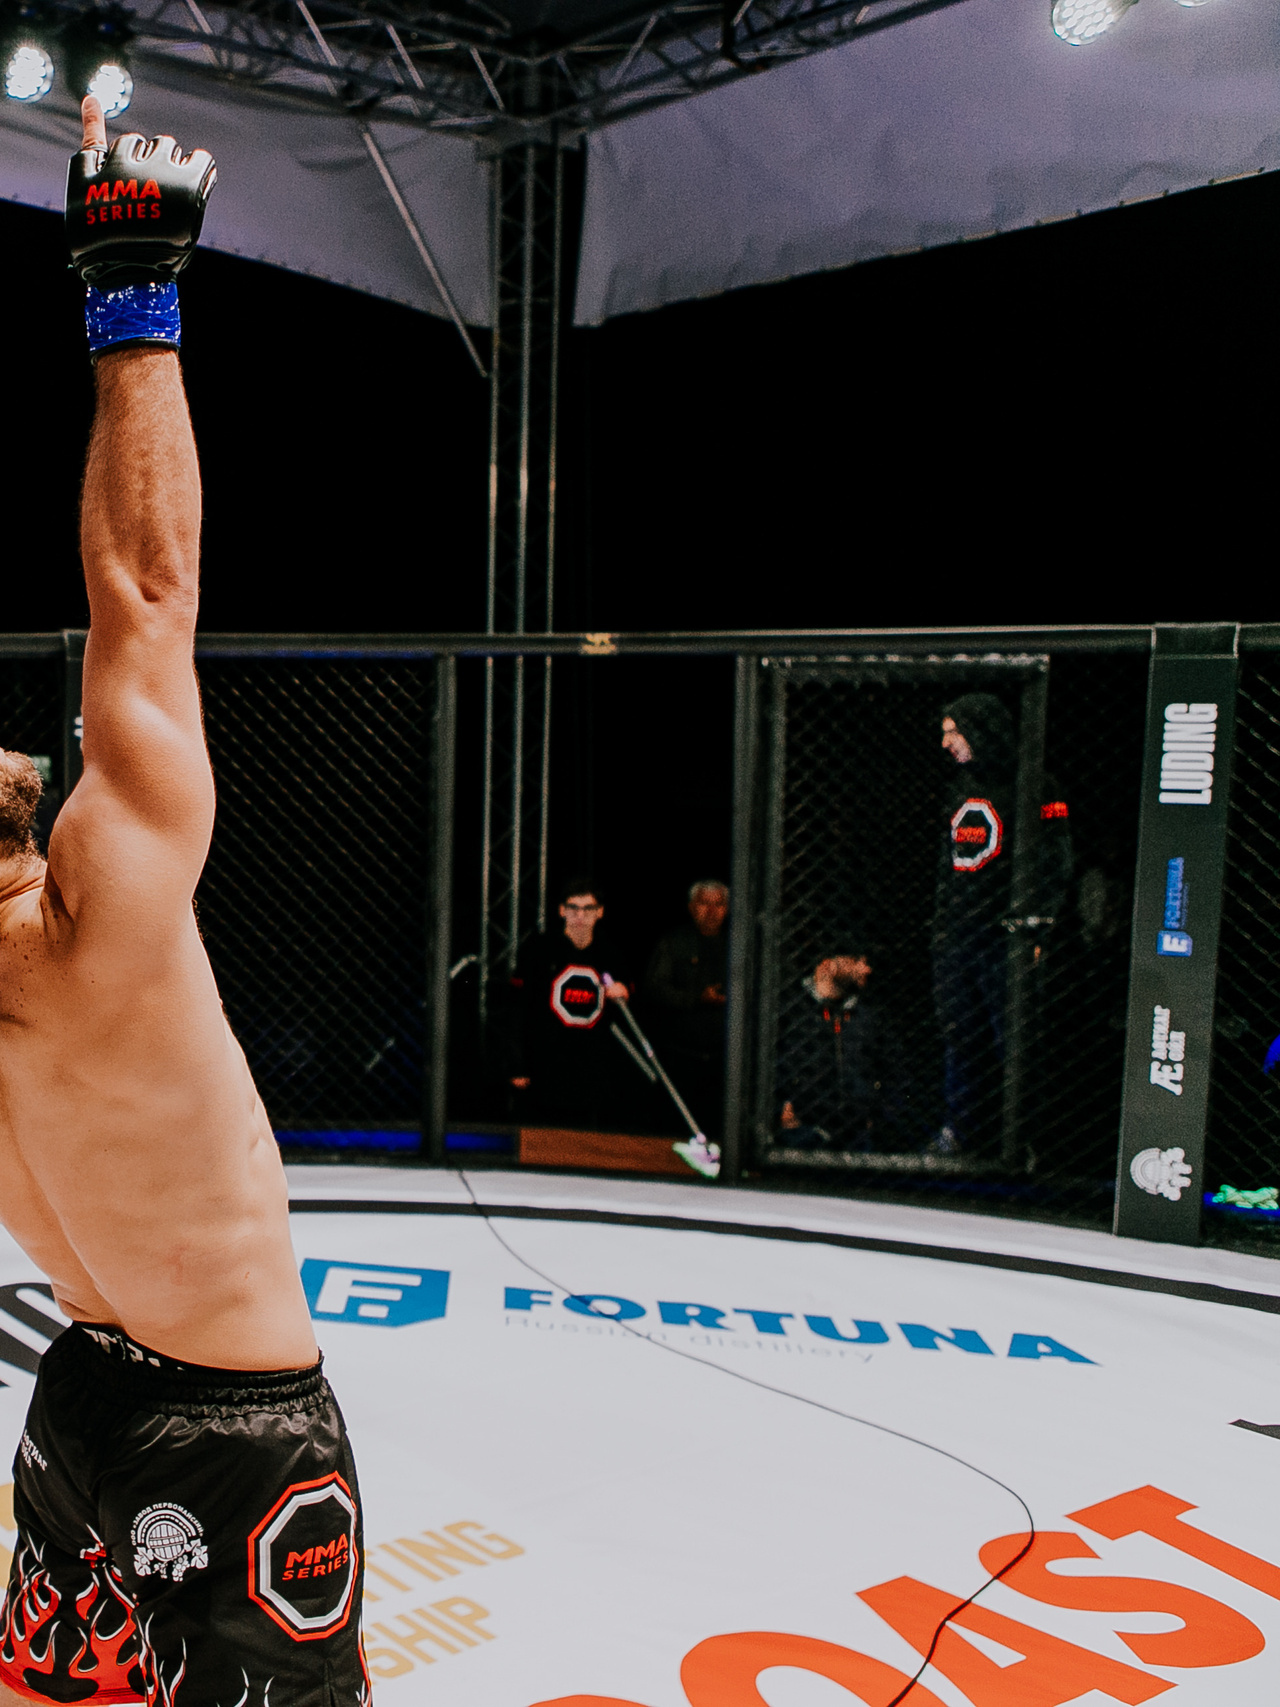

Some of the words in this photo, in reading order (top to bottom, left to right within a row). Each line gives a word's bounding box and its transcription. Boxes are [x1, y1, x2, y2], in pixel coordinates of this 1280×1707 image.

[85, 178, 161, 206] MMA
[86, 203, 161, 225] SERIES
[1159, 702, 1219, 806] LUDING
[504, 1286, 1102, 1366] FORTUNA
[505, 1316, 668, 1344] Russian
[689, 1332, 875, 1364] distillery
[281, 1550, 349, 1581] SERIES
[285, 1533, 349, 1569] MMA
